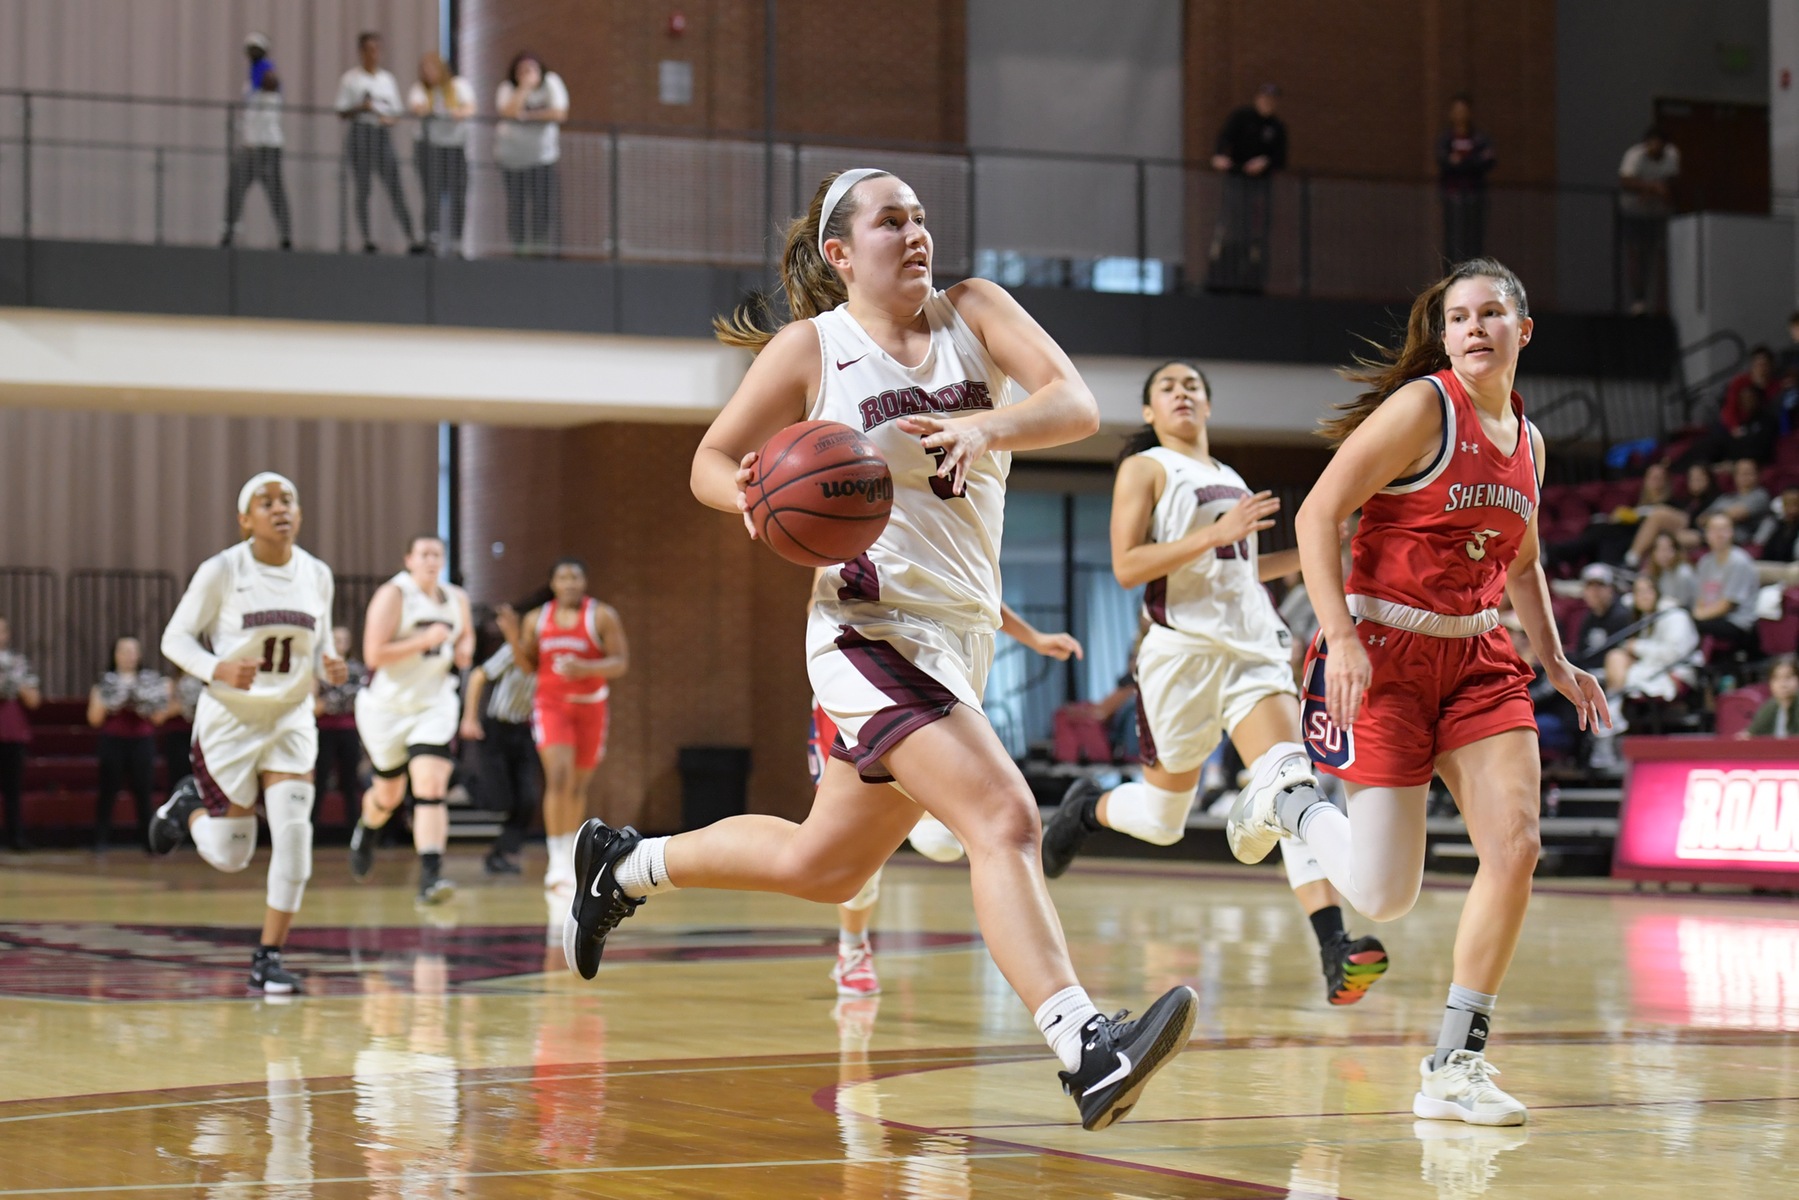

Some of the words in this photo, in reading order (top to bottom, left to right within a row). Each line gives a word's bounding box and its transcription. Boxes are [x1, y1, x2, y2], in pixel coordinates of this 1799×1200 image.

[858, 380, 994, 433] ROANOKE
[820, 476, 894, 504] Wilson
[259, 636, 294, 673] 11
[1308, 711, 1341, 752] SU
